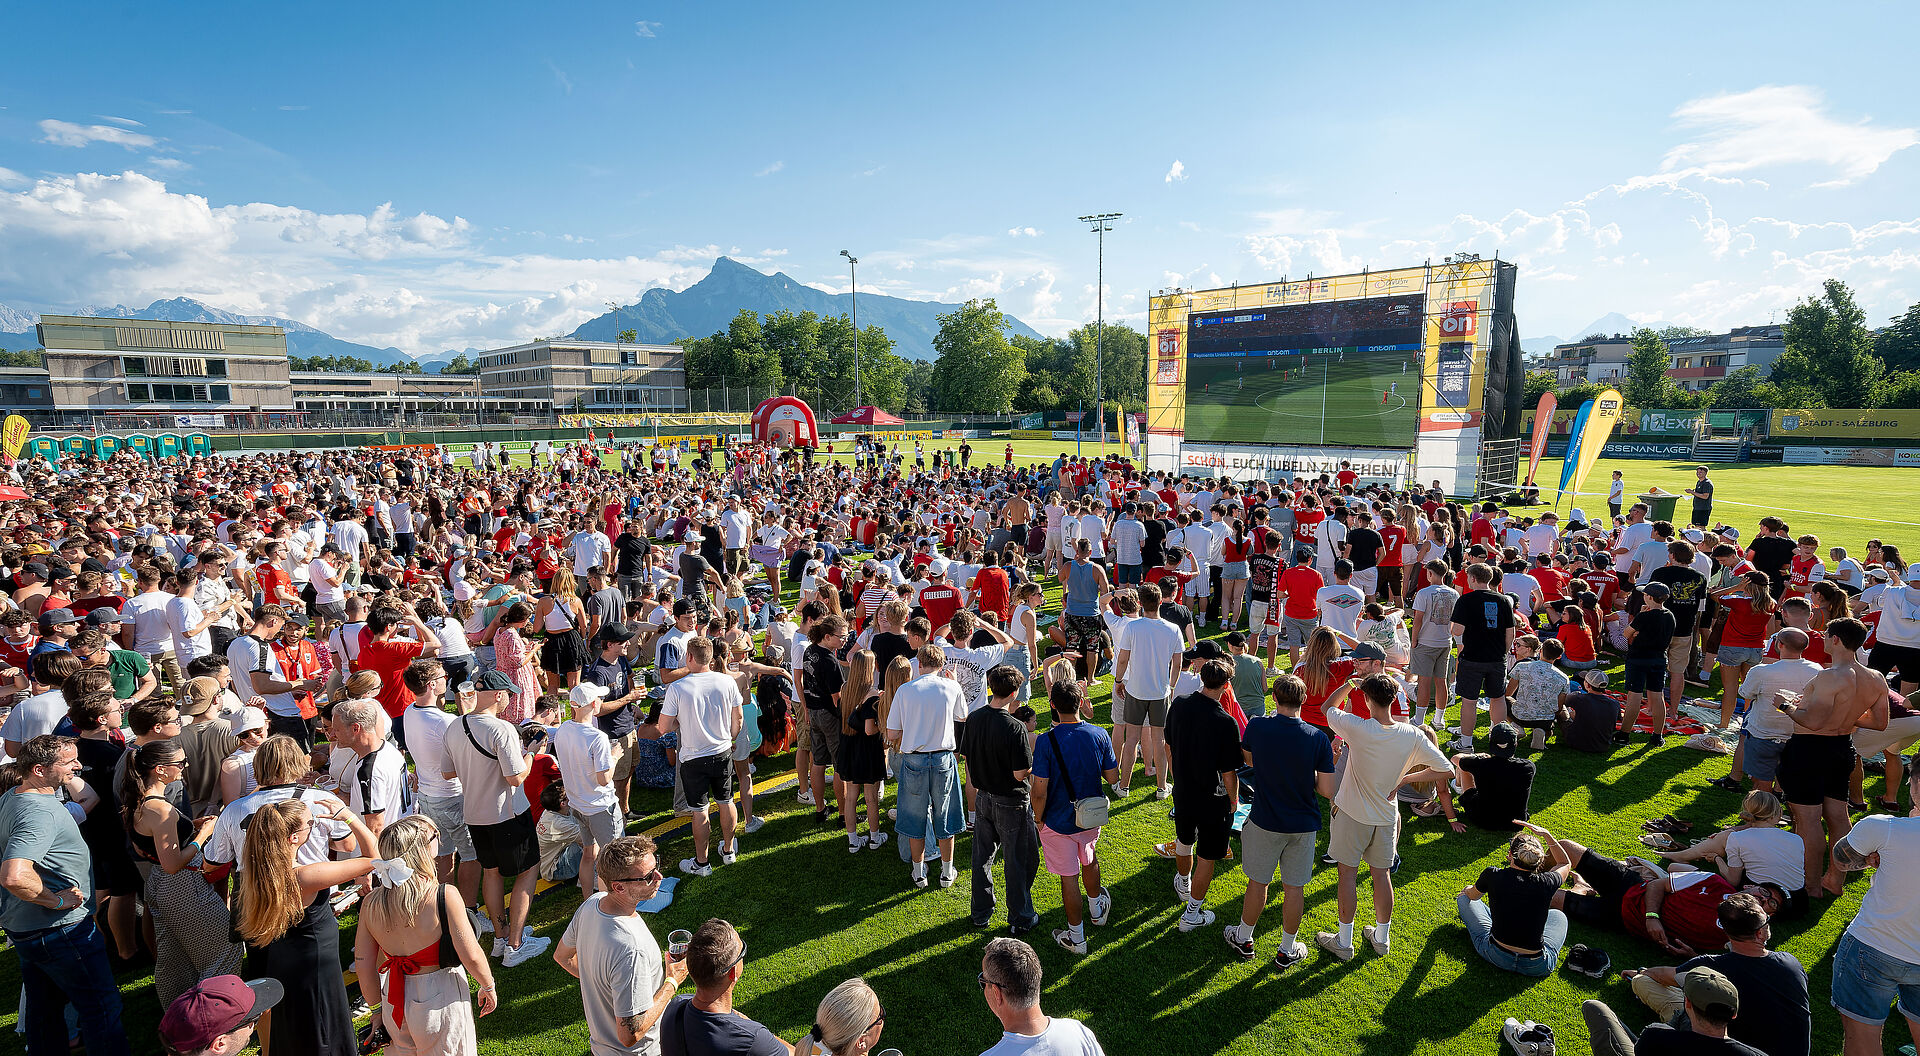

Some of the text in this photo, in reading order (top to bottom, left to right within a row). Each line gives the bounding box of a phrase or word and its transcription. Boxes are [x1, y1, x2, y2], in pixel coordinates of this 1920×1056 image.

[1267, 281, 1329, 298] FANZONE
[1600, 409, 1615, 417] 24
[1030, 418, 1043, 426] EXIT
[1666, 418, 1701, 430] EXIT
[1601, 445, 1692, 454] USSENANLAGEN
[1187, 454, 1397, 478] SCHÖN, EUCH JUBELN ZU EHEN!
[1300, 523, 1318, 537] 85
[1388, 534, 1398, 551] 7
[1594, 582, 1606, 601] 7
